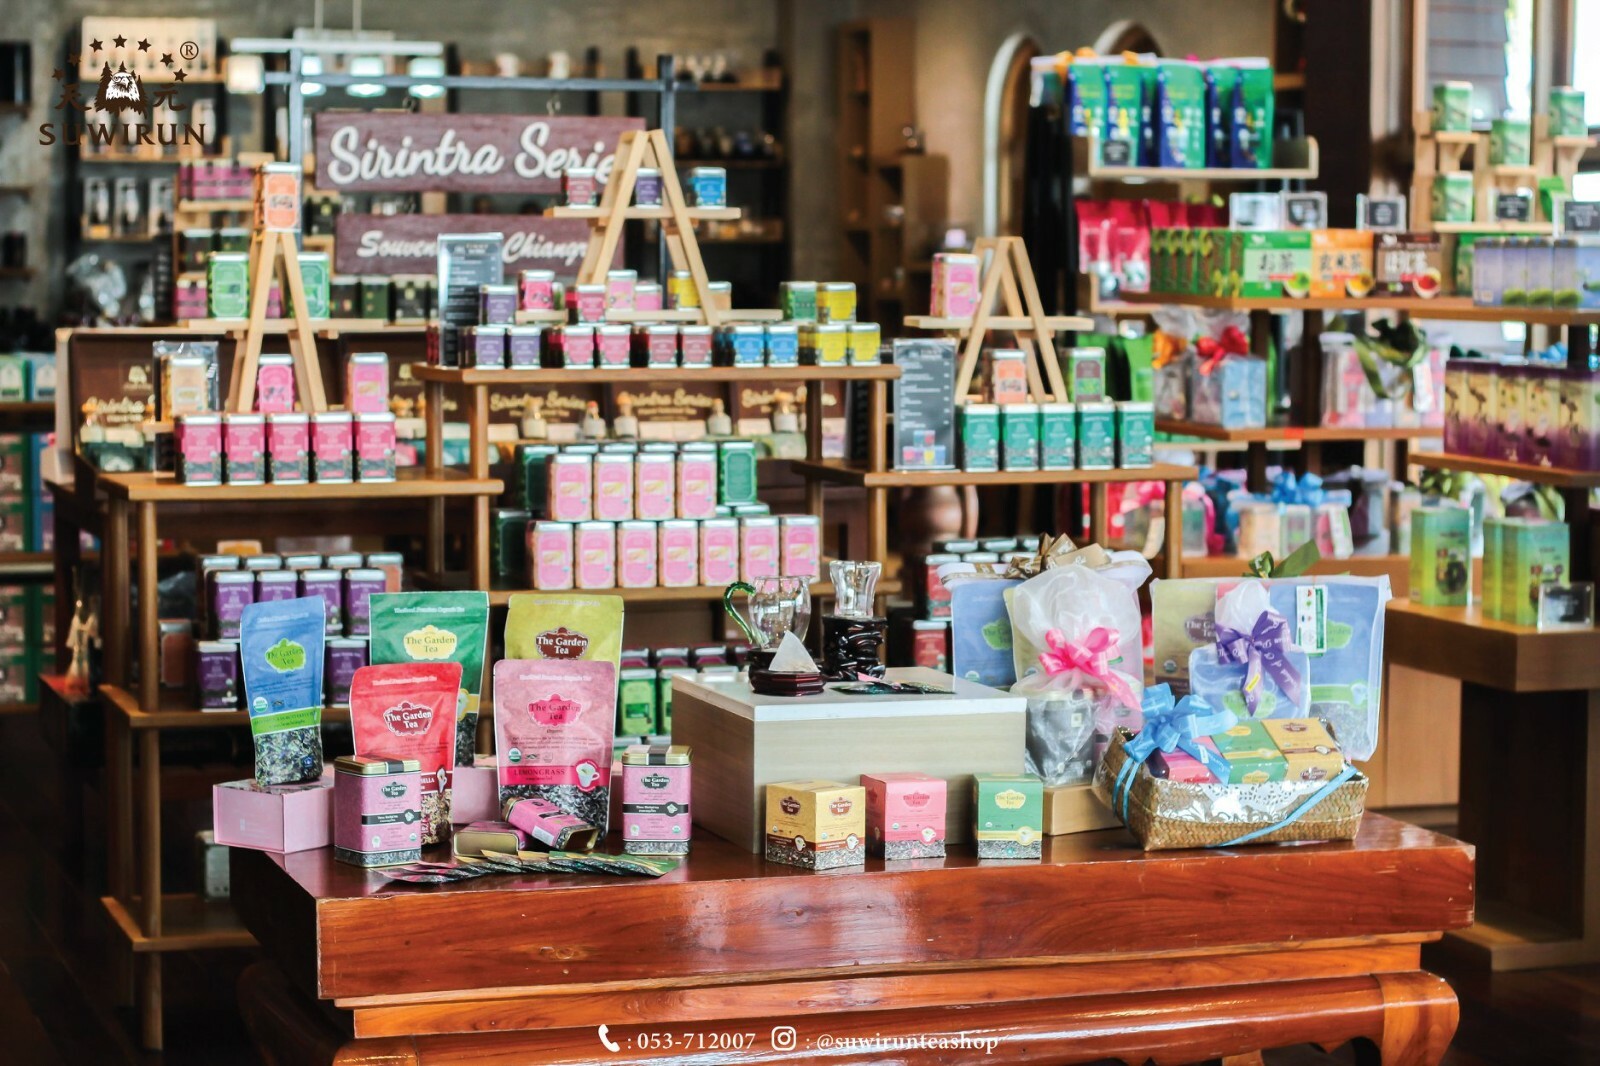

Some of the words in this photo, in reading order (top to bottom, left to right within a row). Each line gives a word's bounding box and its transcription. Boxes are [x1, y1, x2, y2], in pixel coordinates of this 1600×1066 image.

[328, 125, 504, 184] Sirintra
[514, 121, 615, 184] Serie
[357, 230, 438, 258] Souven
[502, 231, 589, 266] Chiangr
[406, 636, 422, 645] The
[424, 635, 455, 644] Garden
[536, 636, 554, 646] The
[555, 637, 588, 647] Garden
[423, 645, 438, 653] Tea
[554, 646, 569, 655] Tea
[530, 704, 547, 712] The
[549, 704, 580, 712] Garden
[386, 714, 402, 722] The
[402, 711, 432, 721] Garden
[402, 720, 418, 729] Tea
[513, 768, 566, 776] LEMONGRASS
